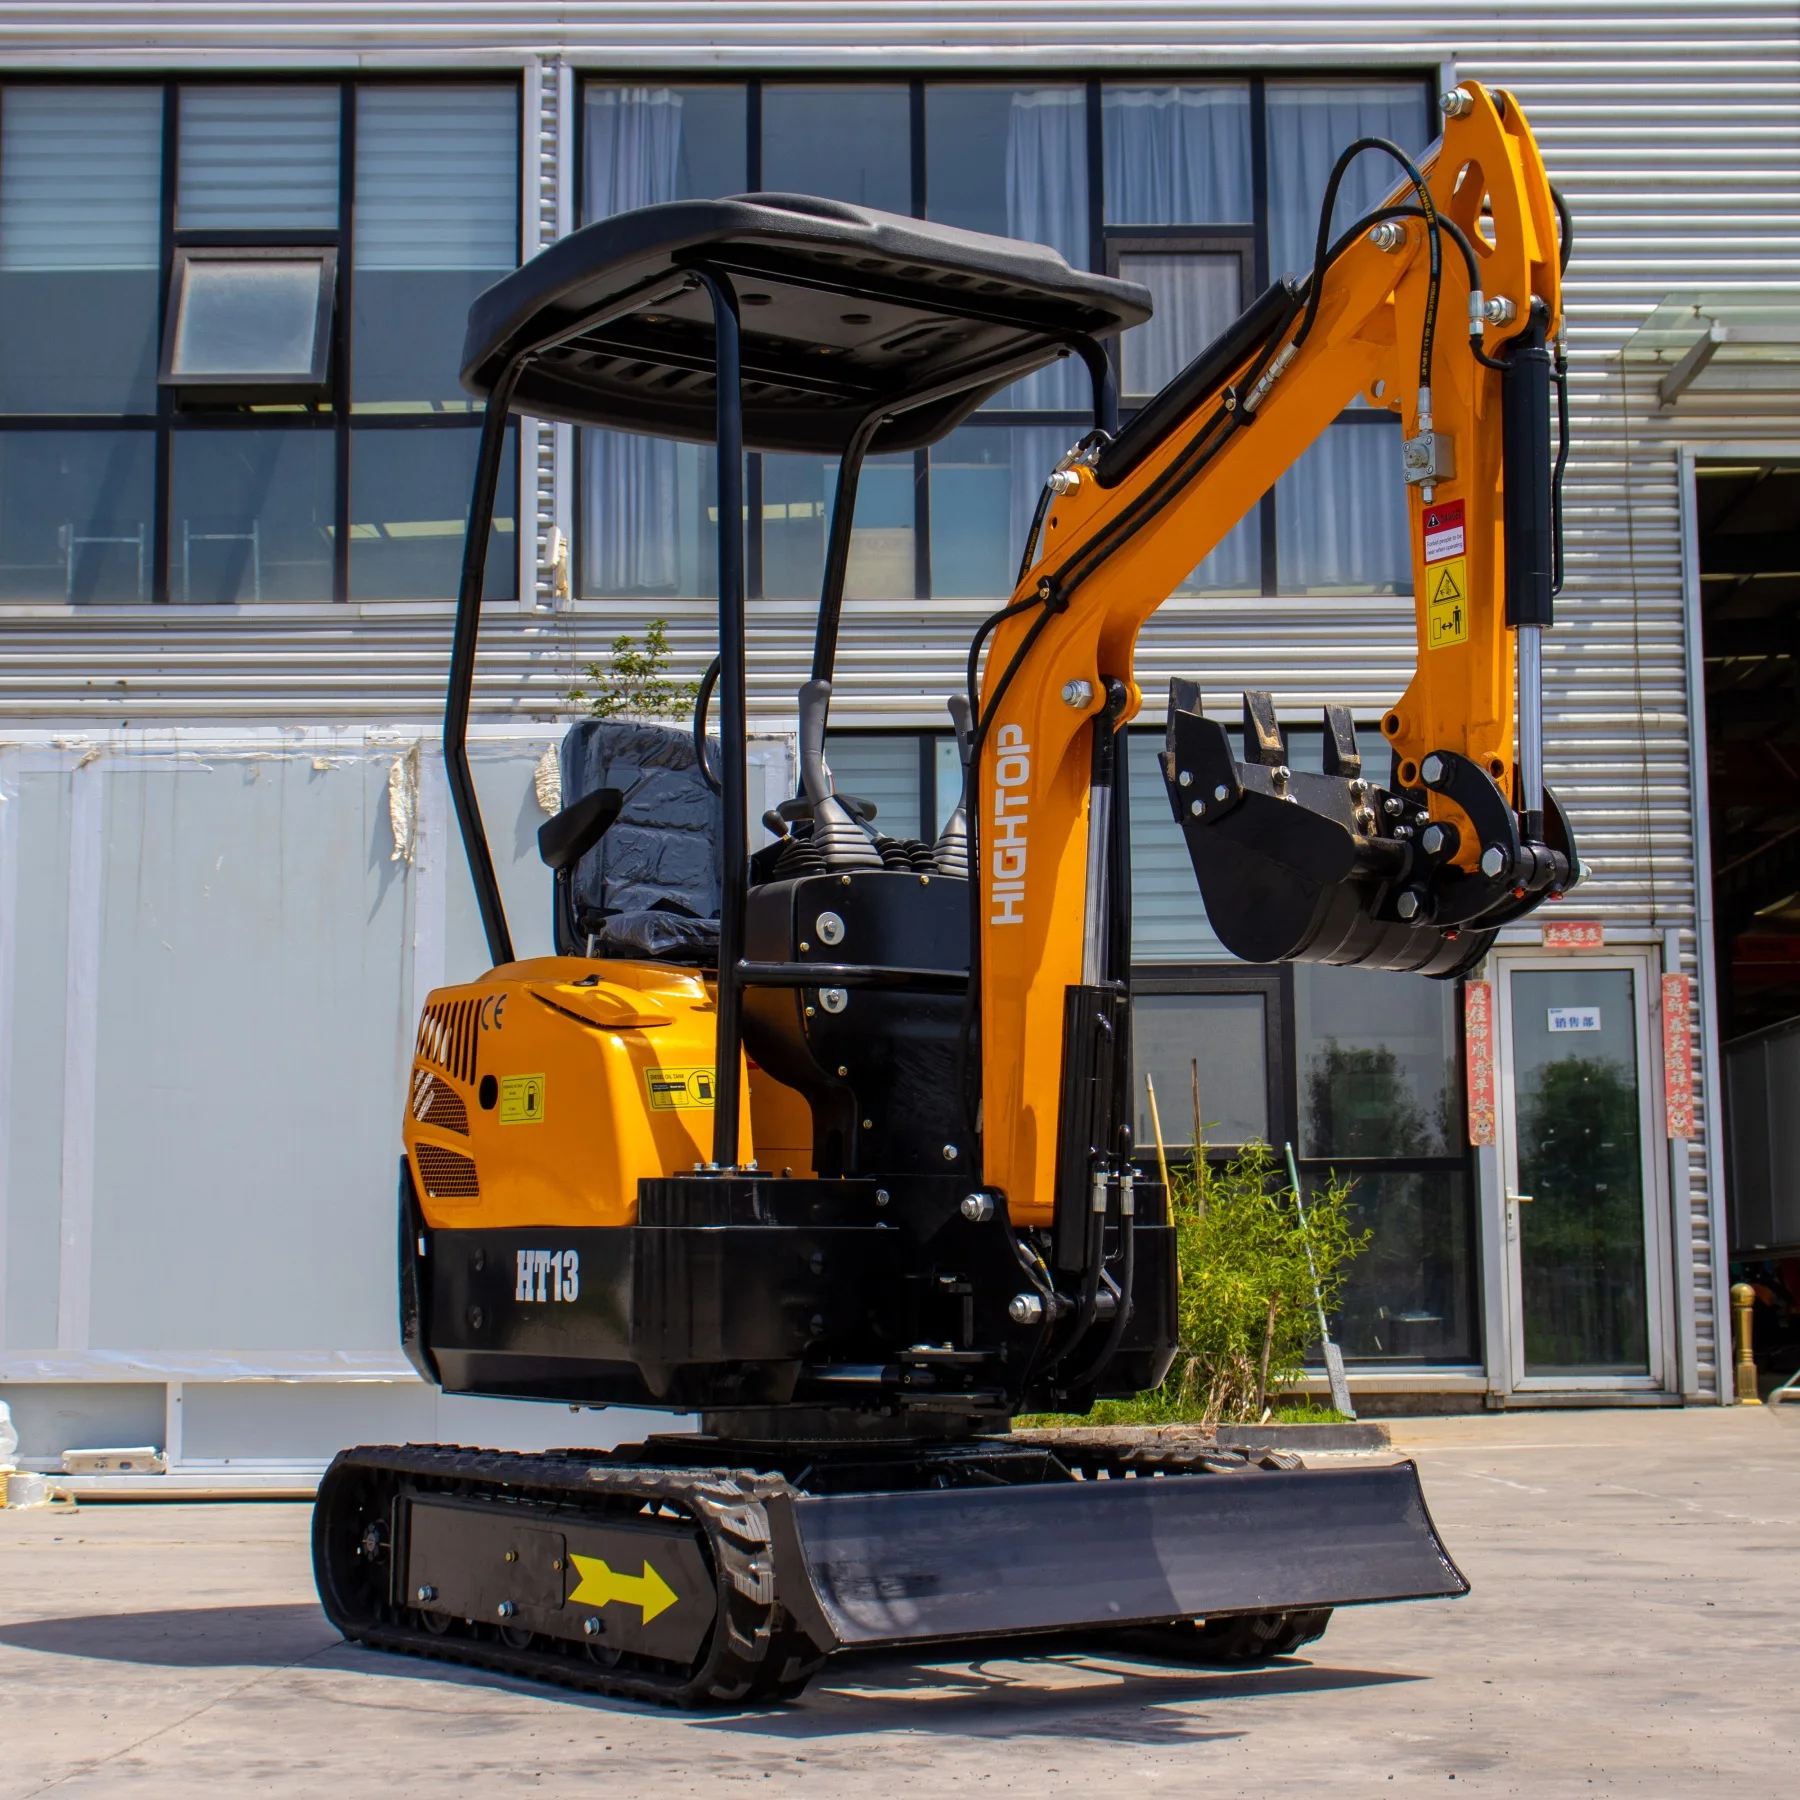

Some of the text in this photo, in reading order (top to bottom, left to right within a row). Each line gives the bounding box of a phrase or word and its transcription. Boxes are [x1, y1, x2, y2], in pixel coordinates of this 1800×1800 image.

[1418, 184, 1435, 224] YONGJIE
[1428, 281, 1437, 310] HYDRAULIC
[1439, 536, 1452, 546] people
[1446, 542, 1463, 551] operating
[991, 724, 1030, 925] HIGHTOP
[1554, 1016, 1594, 1028] 销售部
[515, 1249, 580, 1303] HT13
